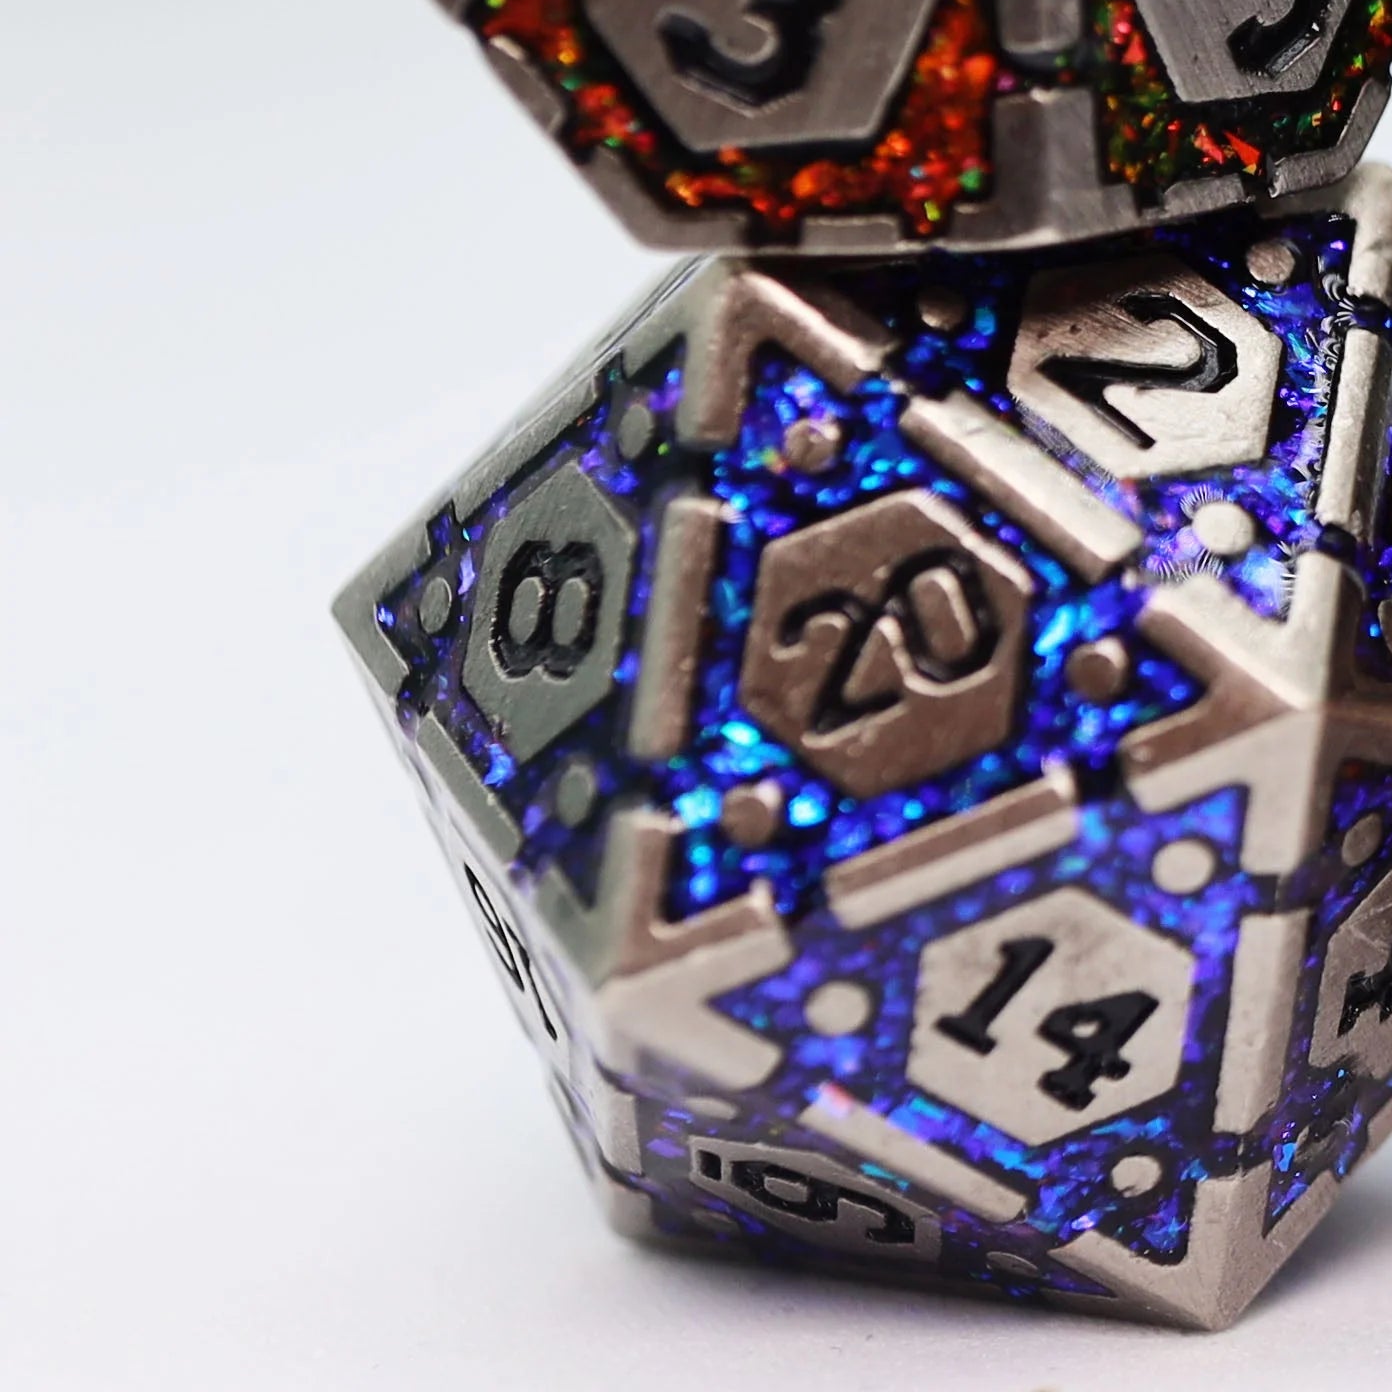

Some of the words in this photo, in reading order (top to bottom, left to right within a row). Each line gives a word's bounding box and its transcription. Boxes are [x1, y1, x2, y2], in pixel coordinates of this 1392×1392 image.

[1036, 291, 1239, 448] 2
[490, 540, 602, 682] 8
[775, 543, 1000, 738] 20
[934, 937, 1160, 1110] 14
